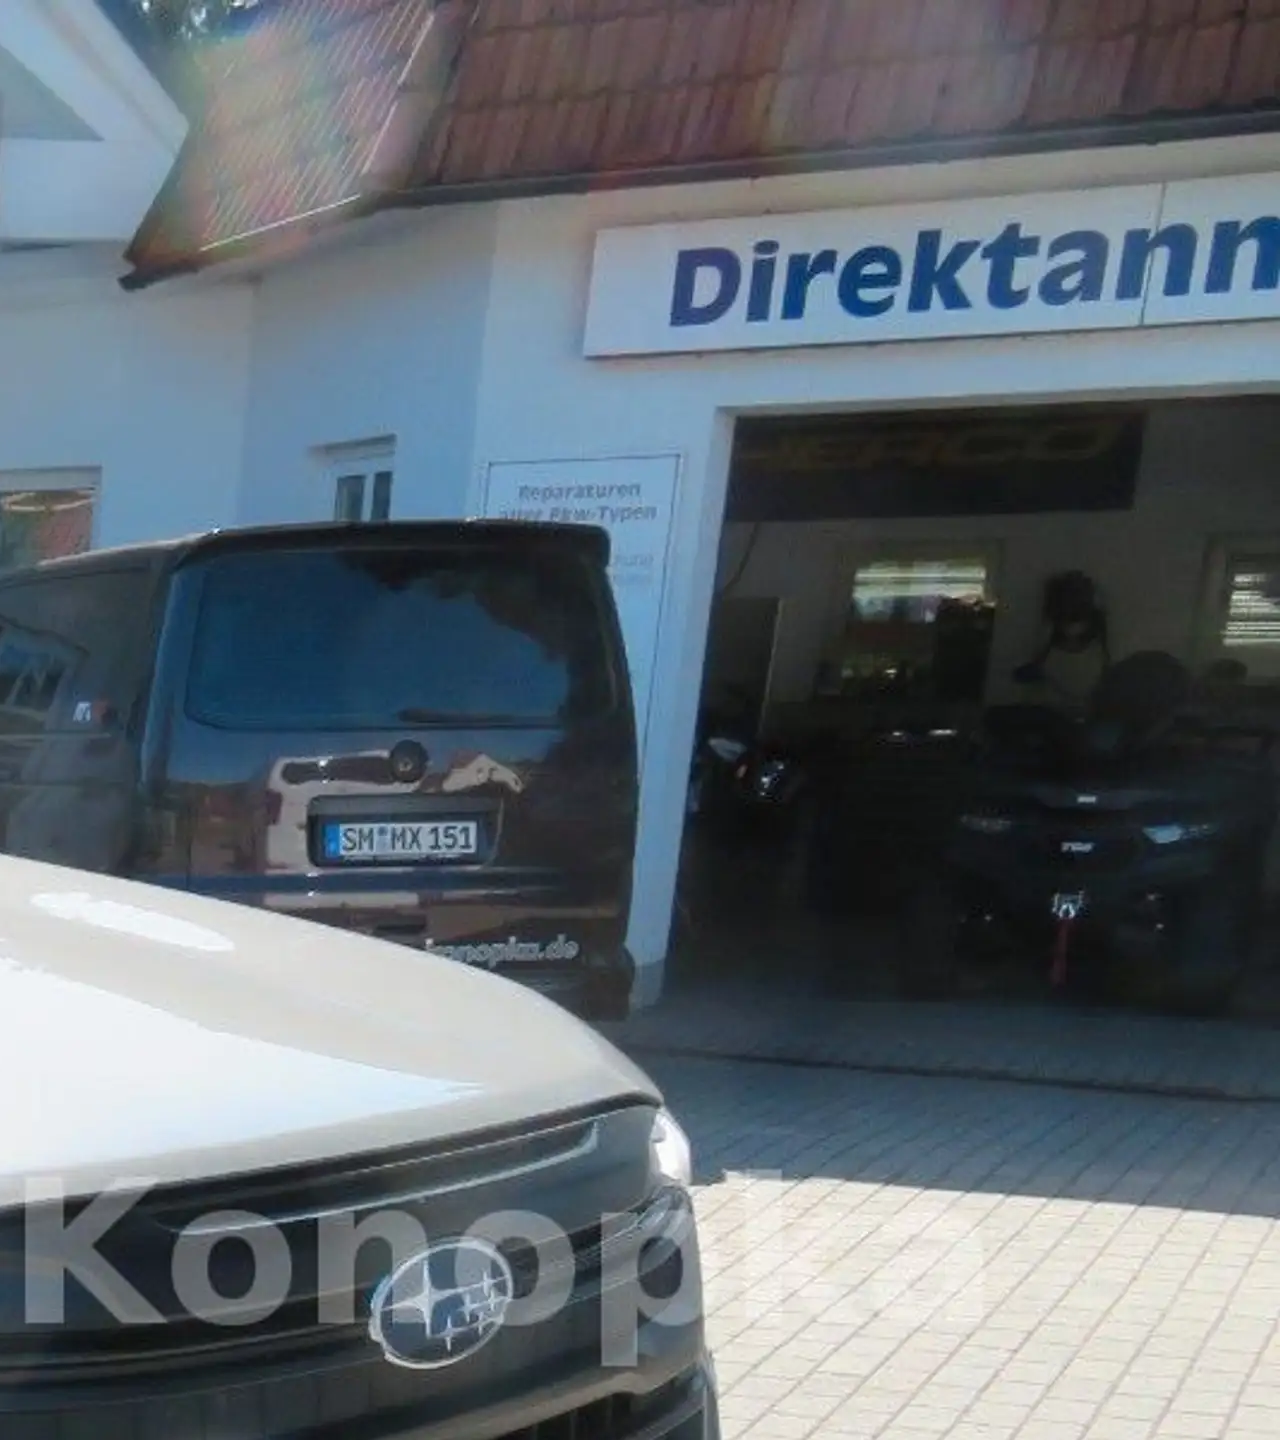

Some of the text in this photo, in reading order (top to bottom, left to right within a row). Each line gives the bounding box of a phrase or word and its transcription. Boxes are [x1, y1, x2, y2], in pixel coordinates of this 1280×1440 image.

[669, 215, 1280, 327] Direktann
[518, 482, 642, 502] Reparaturen
[341, 825, 472, 851] SM MX 151
